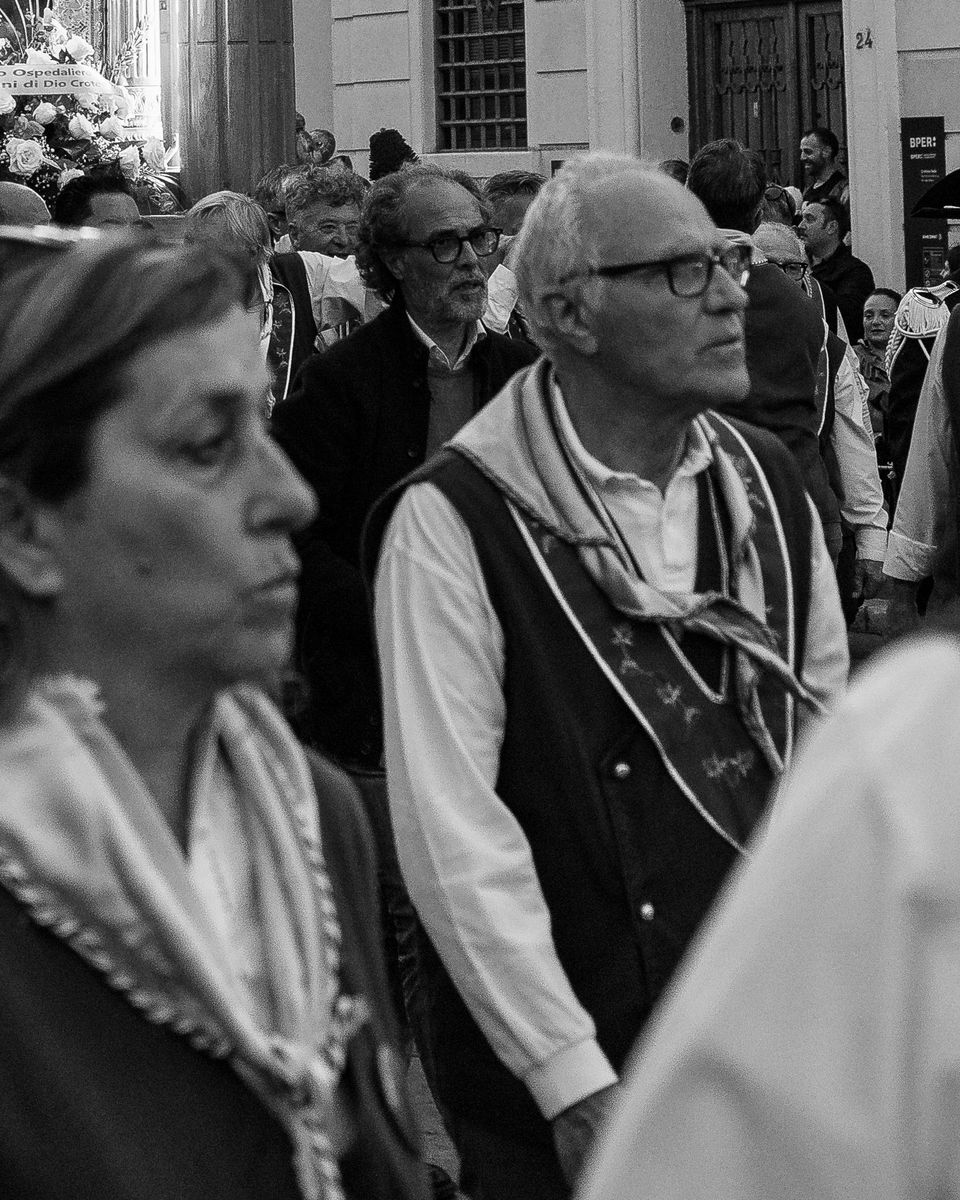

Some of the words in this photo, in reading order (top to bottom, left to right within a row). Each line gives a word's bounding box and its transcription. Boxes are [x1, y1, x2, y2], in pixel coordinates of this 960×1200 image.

[855, 28, 873, 49] 24
[23, 79, 38, 88] di
[43, 79, 66, 88] Dio
